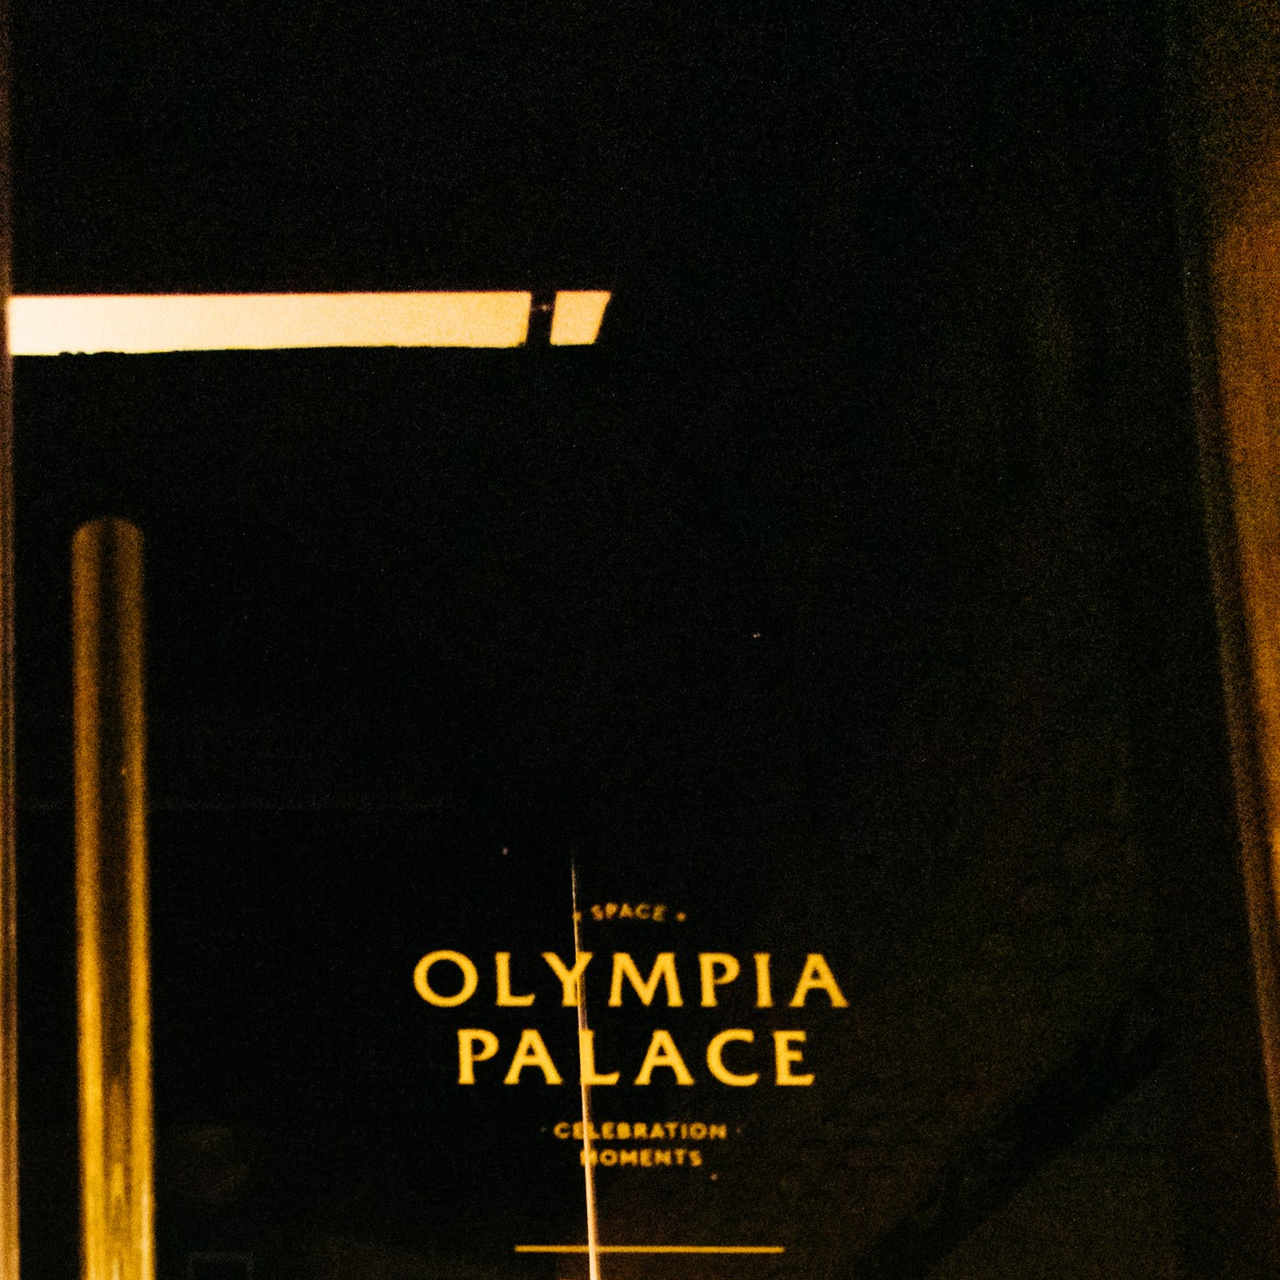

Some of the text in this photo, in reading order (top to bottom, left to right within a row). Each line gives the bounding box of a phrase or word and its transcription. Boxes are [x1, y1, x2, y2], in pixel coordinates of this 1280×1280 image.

[590, 902, 667, 922] SPACE
[413, 949, 849, 1009] OLYMPIA
[456, 1028, 816, 1087] PALACE
[553, 1121, 727, 1141] CELEBRATION
[580, 1148, 703, 1168] MOMENTS
